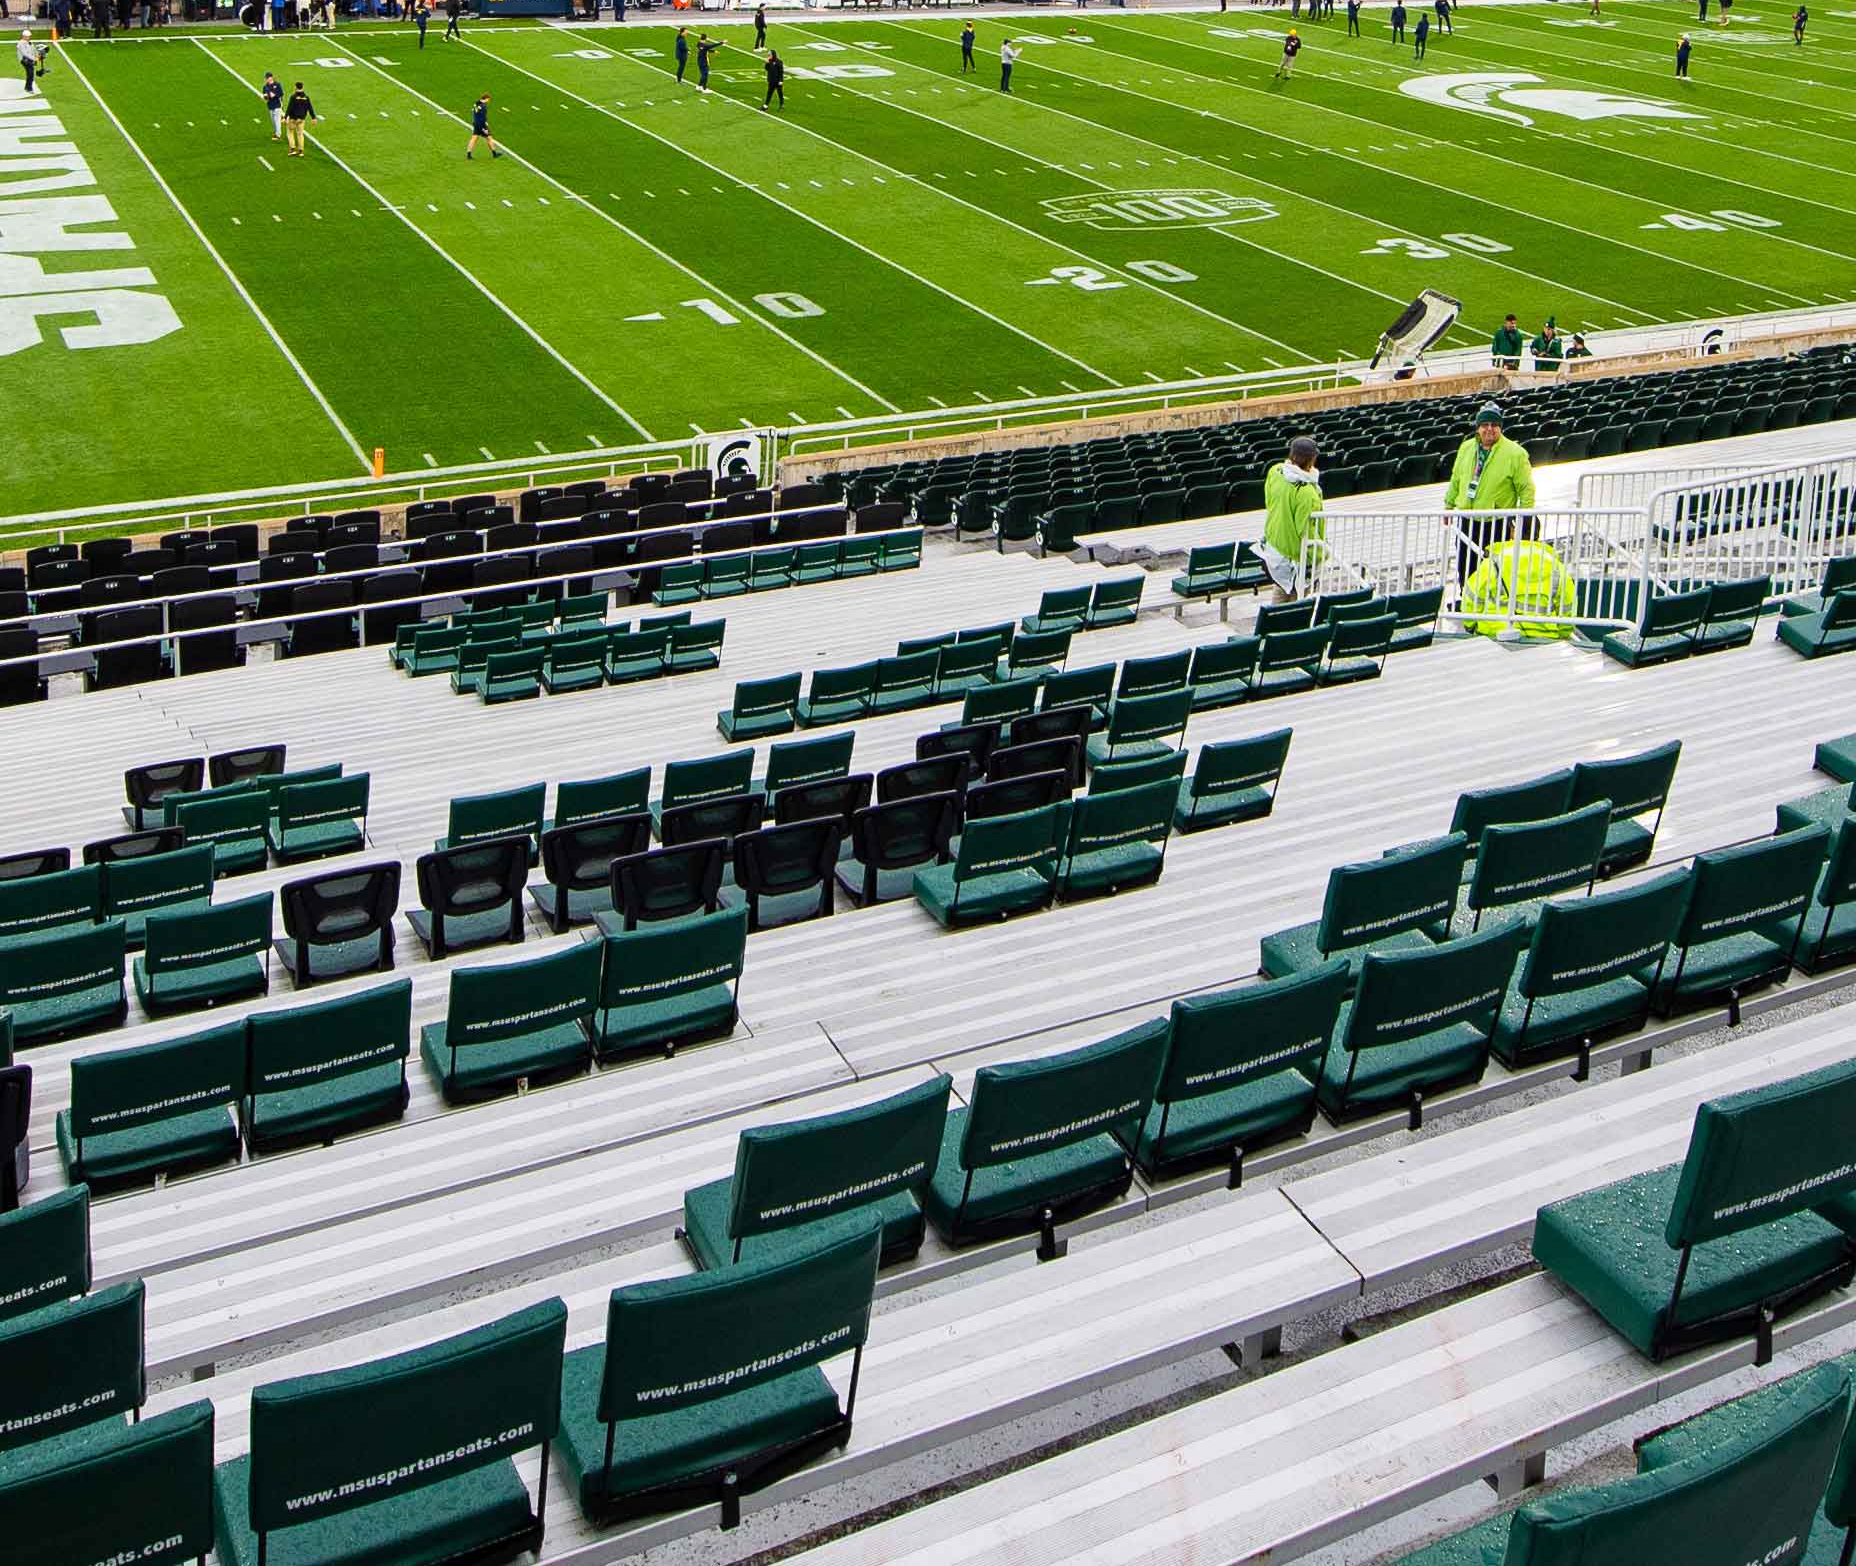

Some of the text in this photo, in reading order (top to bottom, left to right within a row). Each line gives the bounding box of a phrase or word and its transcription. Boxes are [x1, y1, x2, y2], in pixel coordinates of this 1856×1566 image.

[1089, 196, 1231, 223] 100
[1656, 209, 1784, 234] 40
[1374, 232, 1515, 261] 30
[1049, 259, 1200, 292] 20
[679, 291, 829, 326] 10
[618, 962, 734, 993] www.msuspartanseats.com
[466, 996, 587, 1029] www.msuspartanseats.com
[1376, 985, 1502, 1031] www.msuspartanseats.com
[263, 1042, 396, 1079] www.msuspartanseats.com
[1185, 1035, 1323, 1083] www.msuspartanseats.com
[90, 1084, 232, 1124] www.msuspartanseats.com
[990, 1098, 1141, 1152] www.msuspartanseats.com
[759, 1160, 925, 1220] www.msuspartanseats.com
[635, 1323, 852, 1403] www.msuspartanseats.com
[285, 1421, 535, 1511] www.msuspartanseats.com
